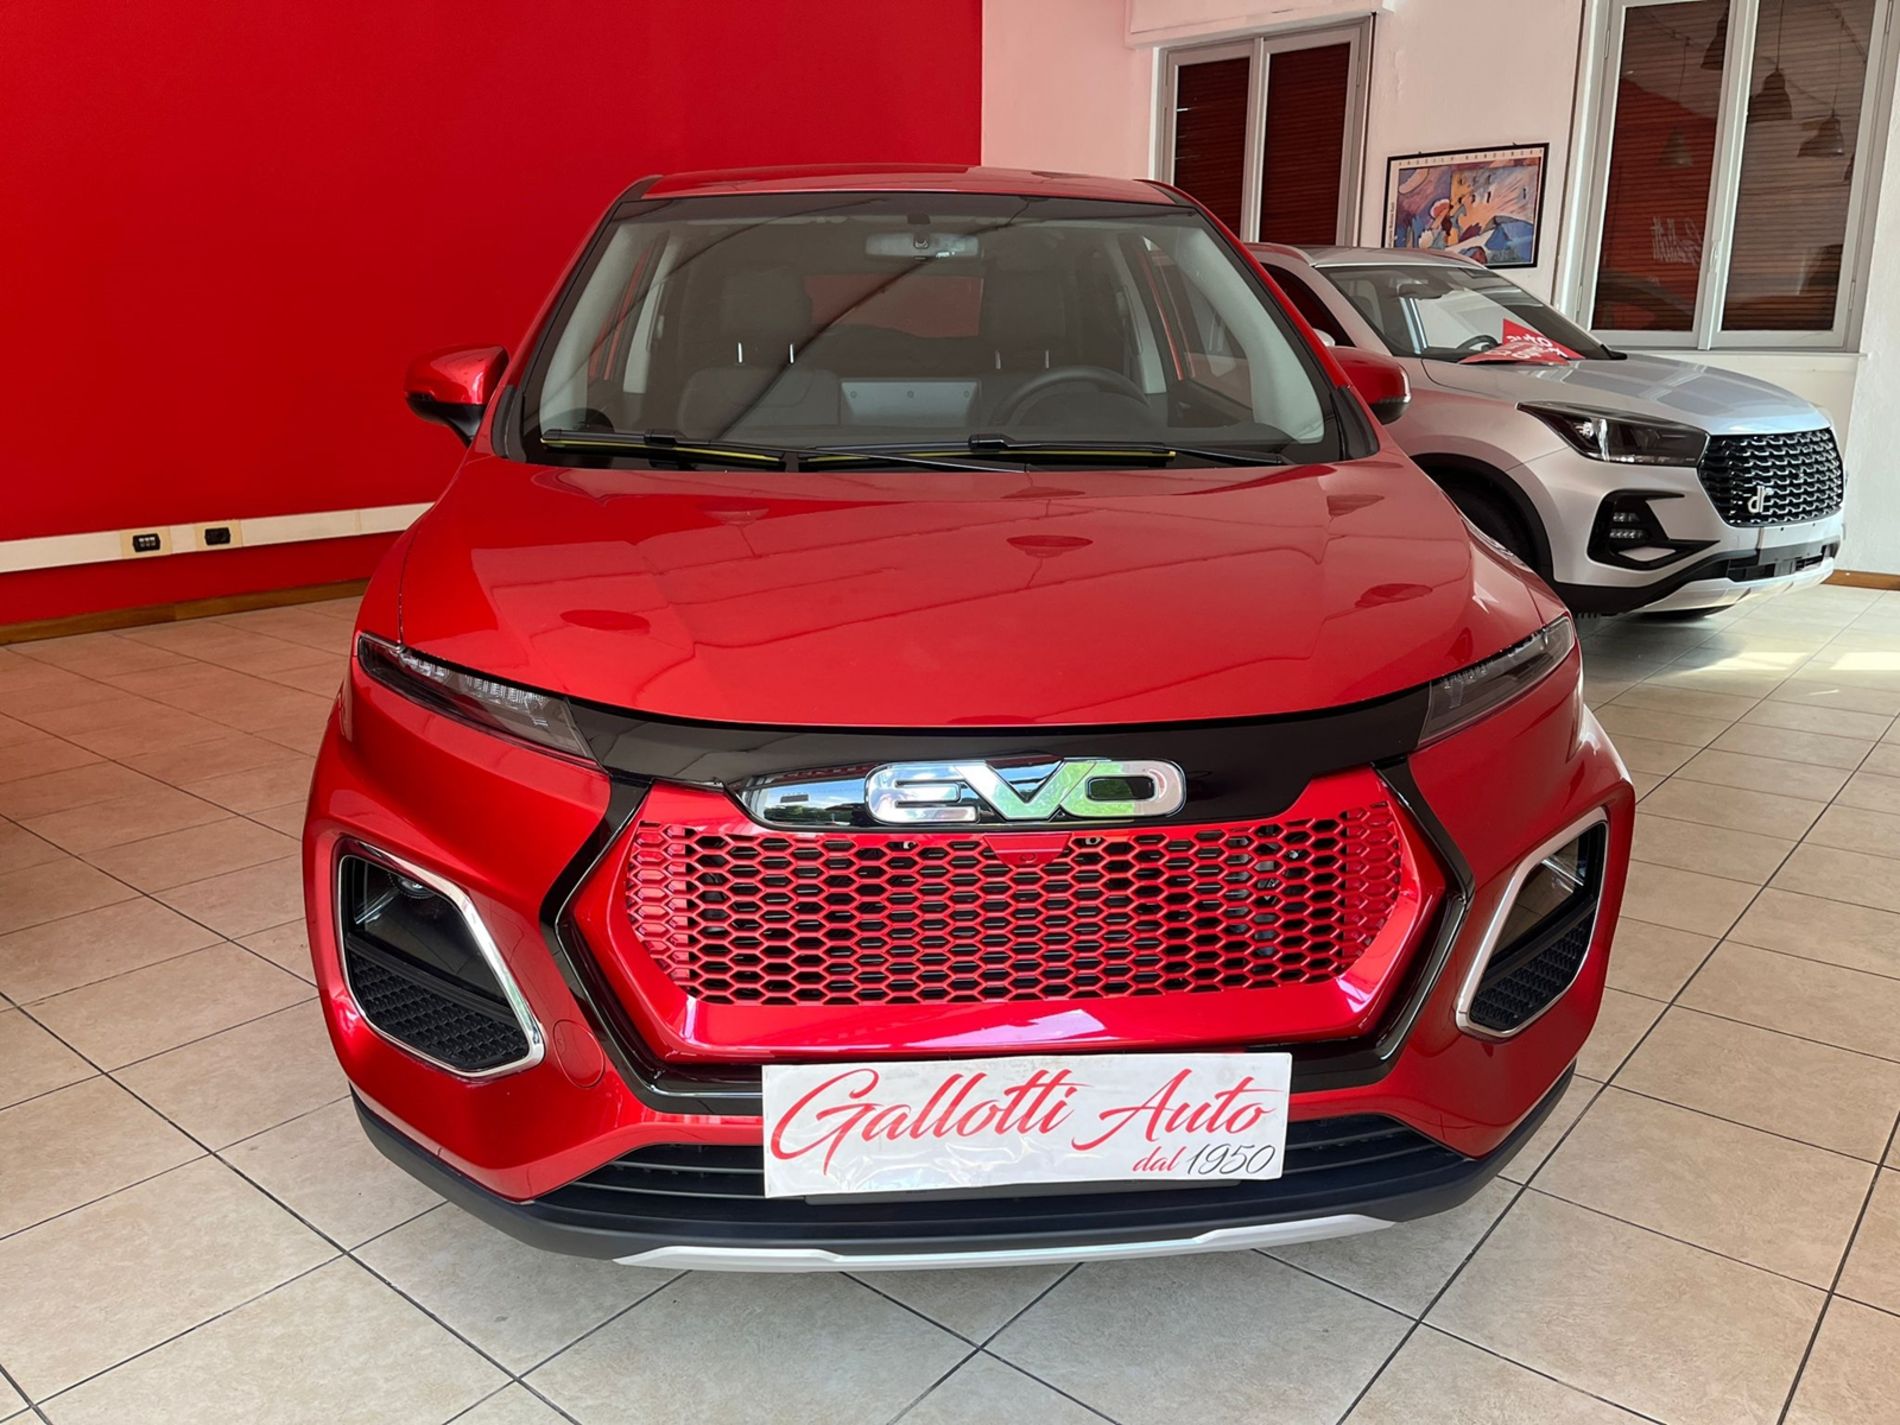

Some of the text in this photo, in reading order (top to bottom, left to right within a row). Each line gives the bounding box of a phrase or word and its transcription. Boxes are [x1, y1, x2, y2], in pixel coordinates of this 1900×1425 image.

[864, 758, 1187, 825] EVO
[769, 1067, 1282, 1176] Gallotti Auto
[1132, 1143, 1276, 1175] dal 1950
